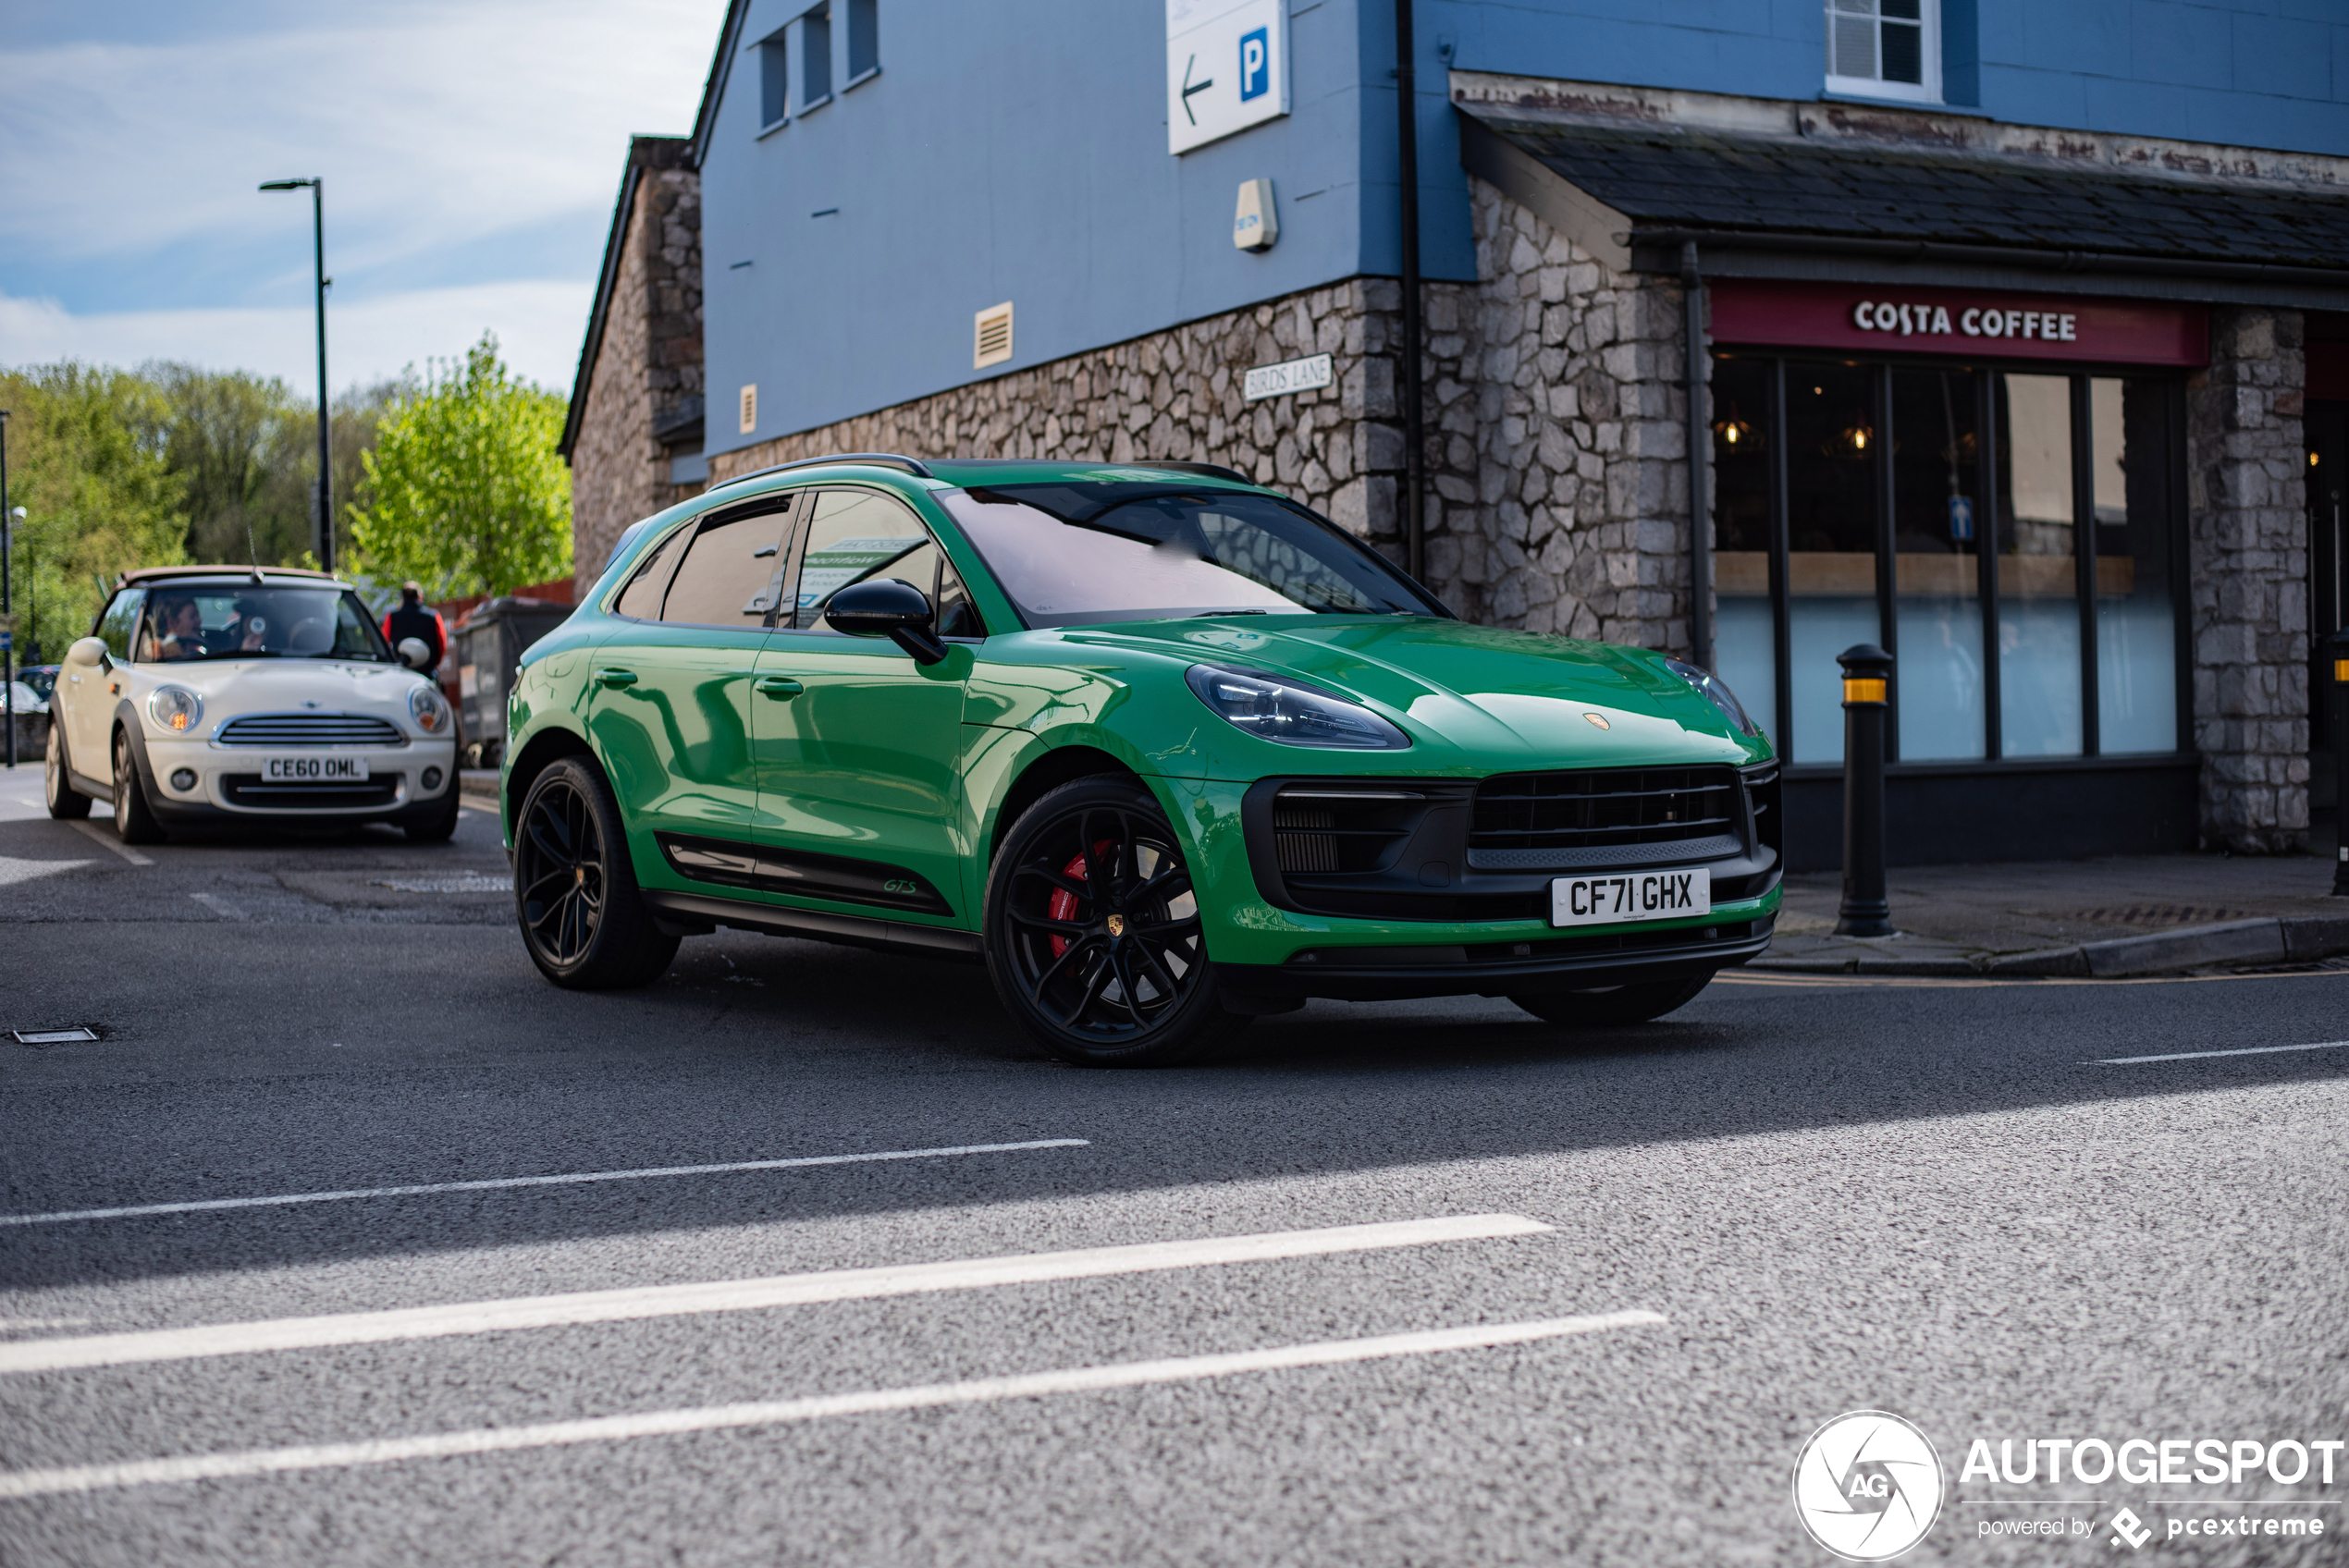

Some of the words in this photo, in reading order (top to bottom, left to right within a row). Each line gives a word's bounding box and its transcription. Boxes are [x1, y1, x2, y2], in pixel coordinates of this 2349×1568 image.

[1243, 38, 1264, 93] P
[1854, 300, 1952, 337] COSTA
[1961, 308, 2076, 341] COFFEE
[1248, 367, 1287, 396] BIRDS
[1293, 359, 1327, 386] LANE
[270, 759, 320, 778] CE60
[326, 759, 361, 778] OML
[883, 879, 916, 894] GTS
[1571, 878, 1634, 915] CF71
[1642, 874, 1692, 911] GHX
